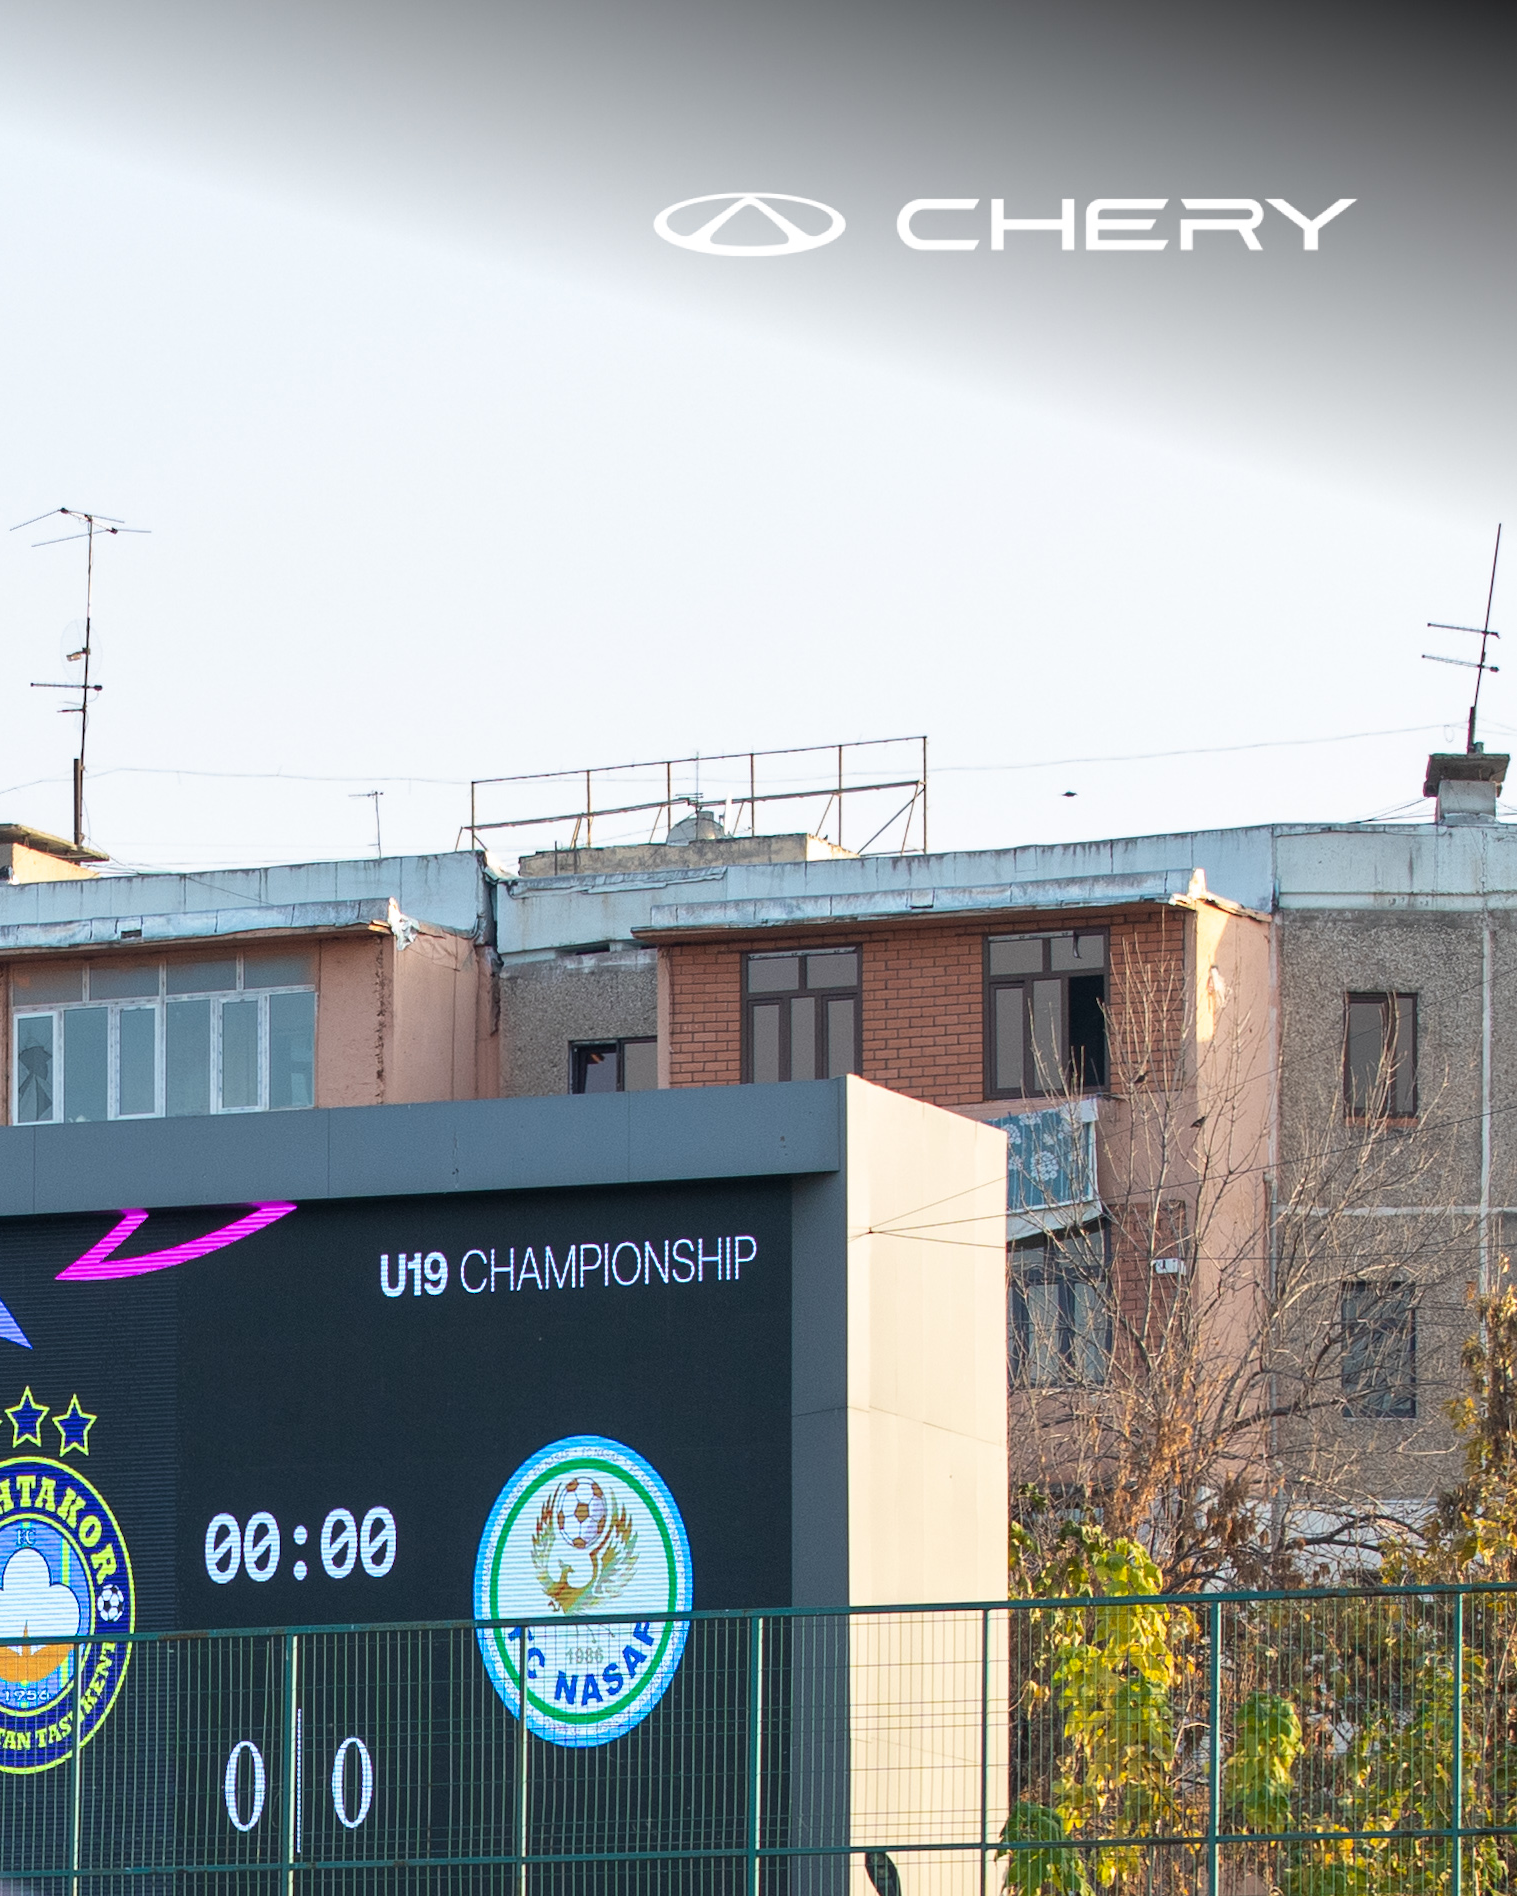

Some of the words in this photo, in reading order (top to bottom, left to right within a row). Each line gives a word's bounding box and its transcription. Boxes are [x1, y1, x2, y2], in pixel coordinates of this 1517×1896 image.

[380, 1251, 449, 1298] U19
[460, 1235, 758, 1295] CHAMPIONSHIP
[16, 1528, 37, 1546] FC
[204, 1505, 398, 1585] 00:00
[565, 1646, 605, 1666] 1986
[2, 1687, 52, 1703] 1956
[224, 1740, 266, 1832] 0
[331, 1736, 373, 1829] 0
